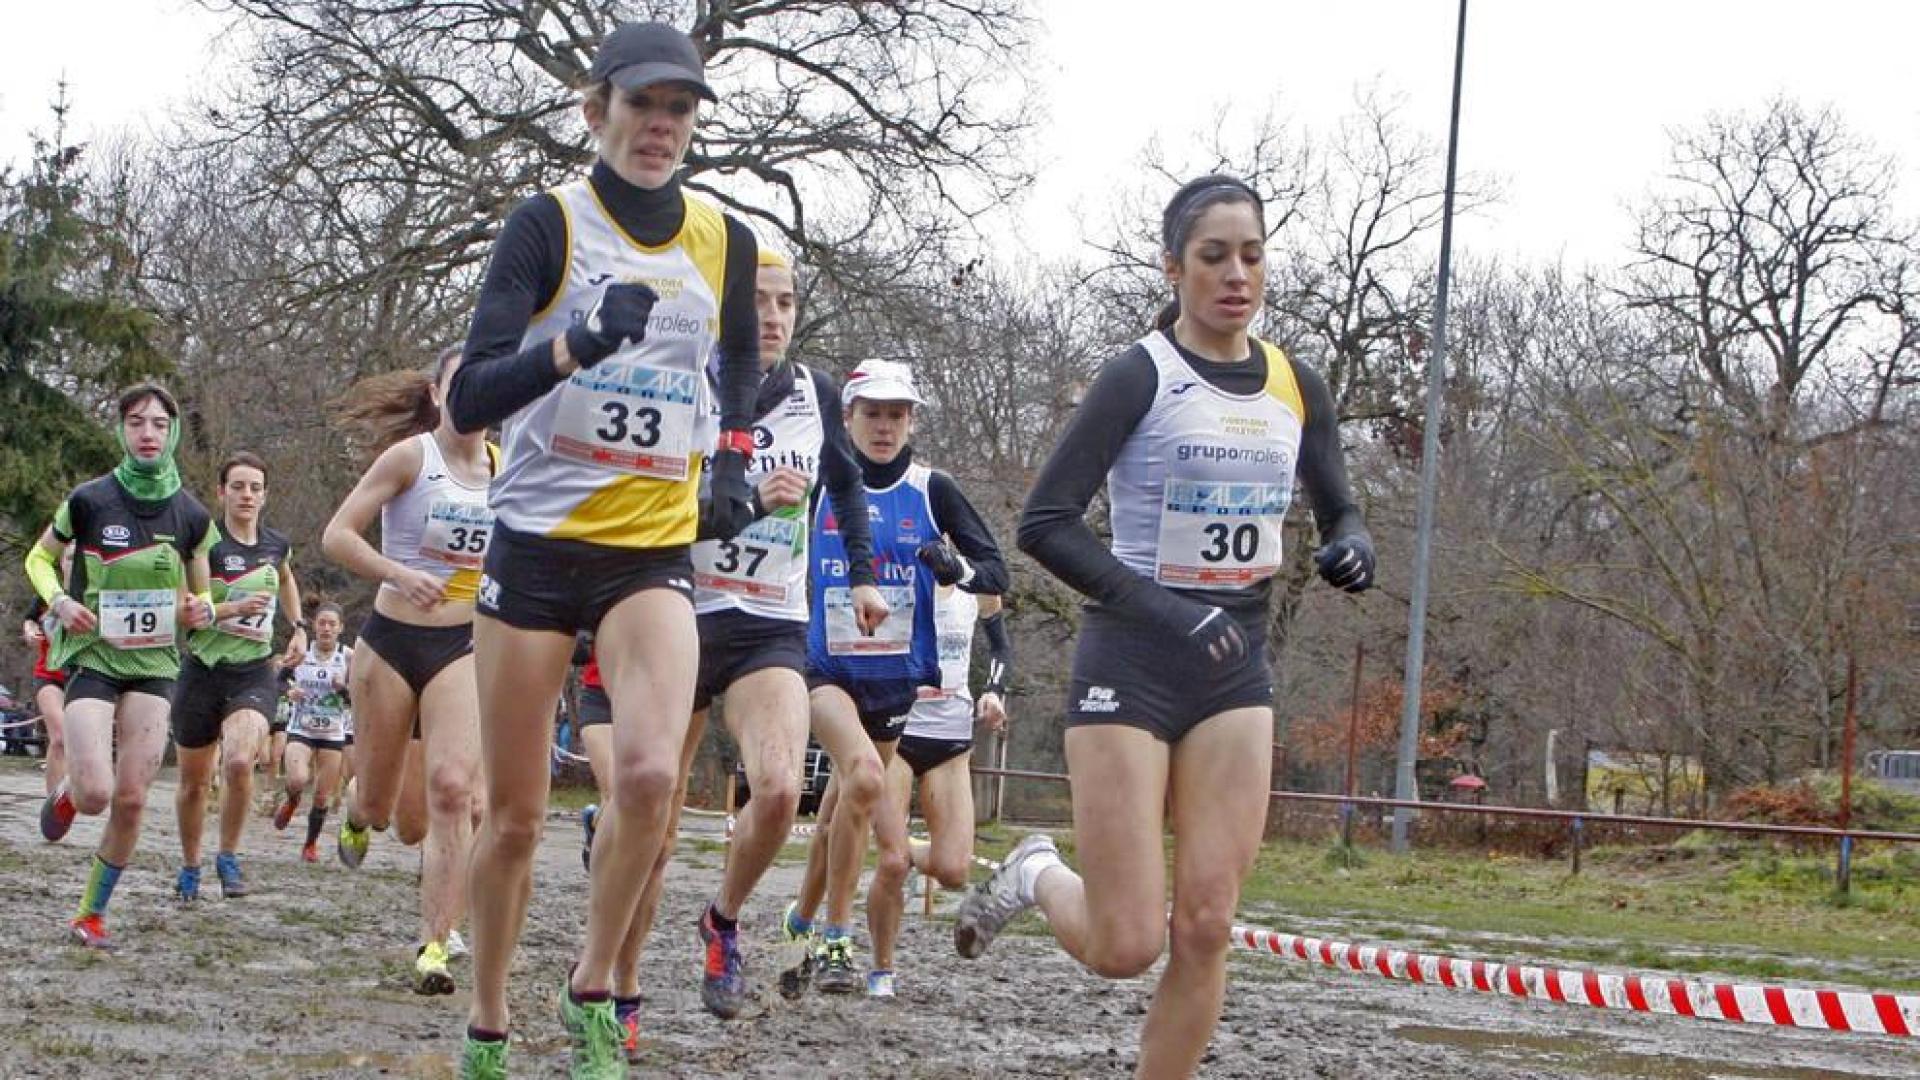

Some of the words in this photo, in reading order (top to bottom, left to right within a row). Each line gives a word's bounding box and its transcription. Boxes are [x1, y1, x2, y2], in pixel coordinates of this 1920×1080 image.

[597, 401, 662, 448] 33
[1177, 444, 1289, 465] grupompleo
[447, 527, 488, 553] 35
[1200, 522, 1260, 563] 30
[714, 539, 769, 577] 37
[123, 611, 158, 635] 19
